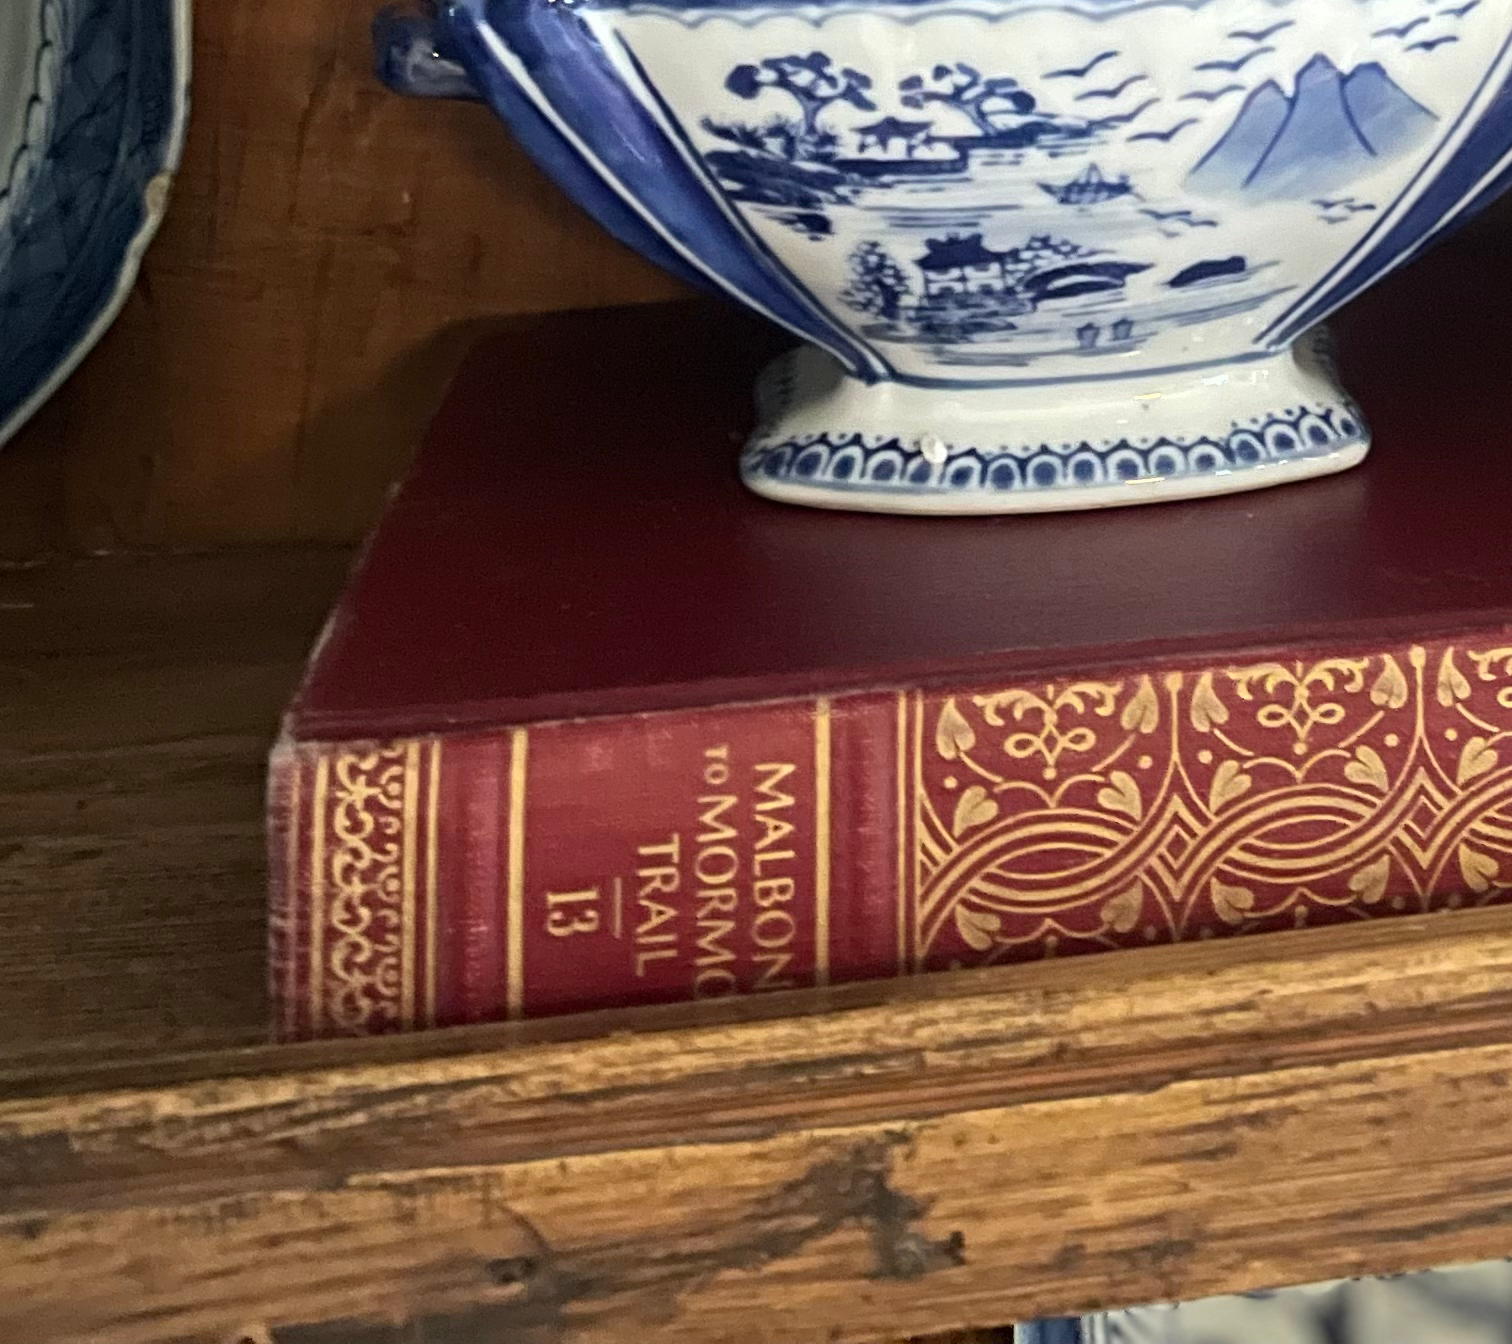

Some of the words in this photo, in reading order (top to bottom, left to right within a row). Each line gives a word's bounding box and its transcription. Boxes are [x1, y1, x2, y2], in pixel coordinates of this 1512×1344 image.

[703, 744, 730, 784] TO
[545, 886, 601, 938] 13
[633, 832, 680, 977] TRAIL
[752, 761, 797, 988] MALBON
